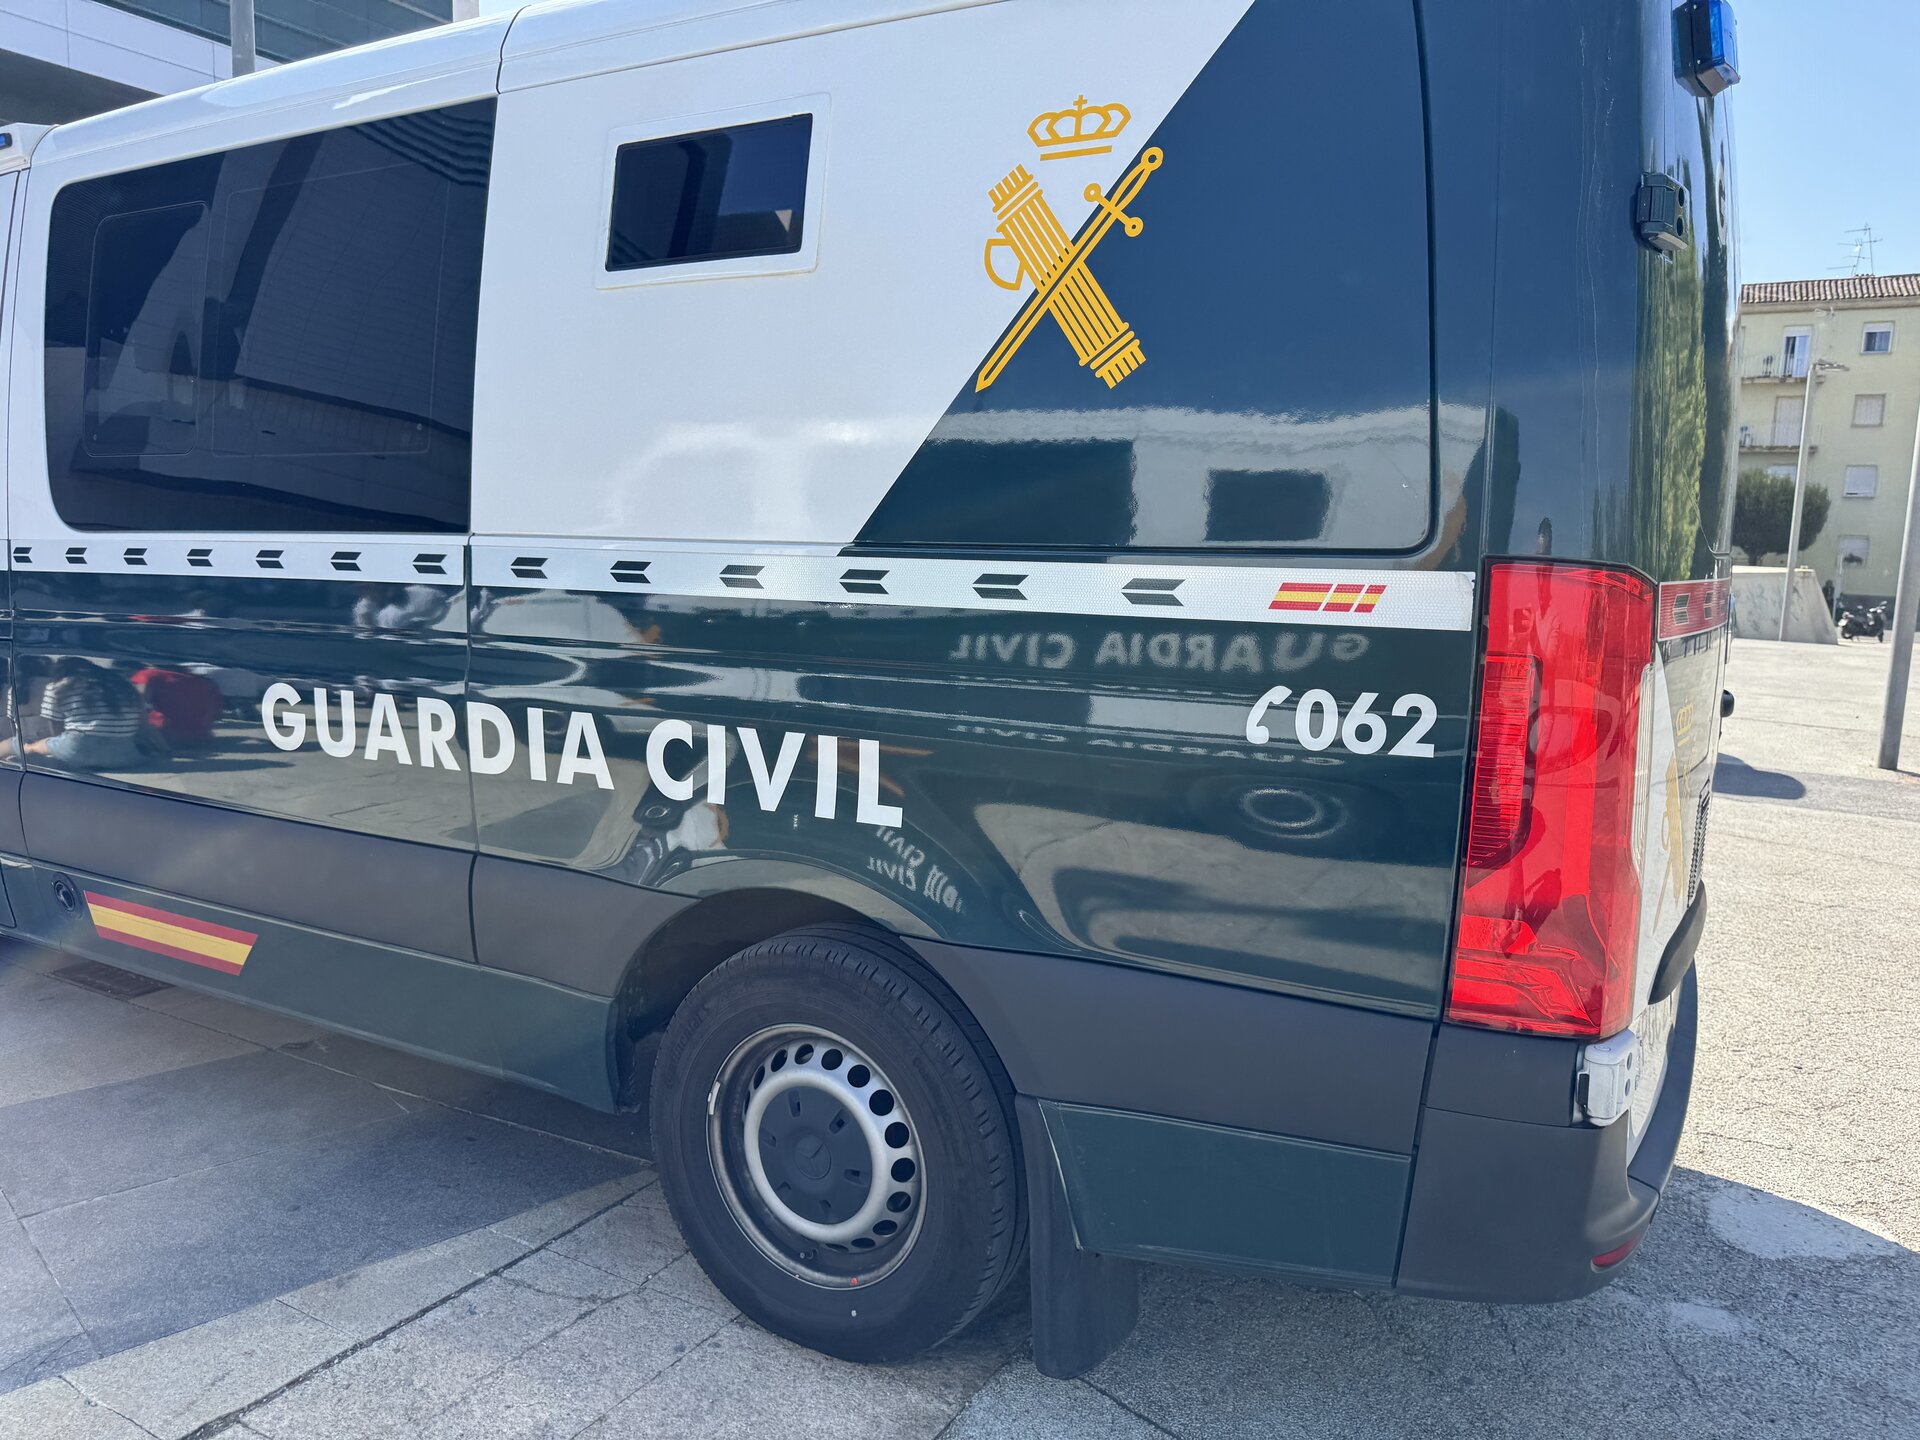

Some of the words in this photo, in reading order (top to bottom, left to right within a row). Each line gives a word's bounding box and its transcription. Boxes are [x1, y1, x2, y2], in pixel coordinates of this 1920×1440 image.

[261, 682, 615, 790] GUARDIA
[645, 718, 904, 829] CIVIL
[1294, 688, 1438, 758] 062
